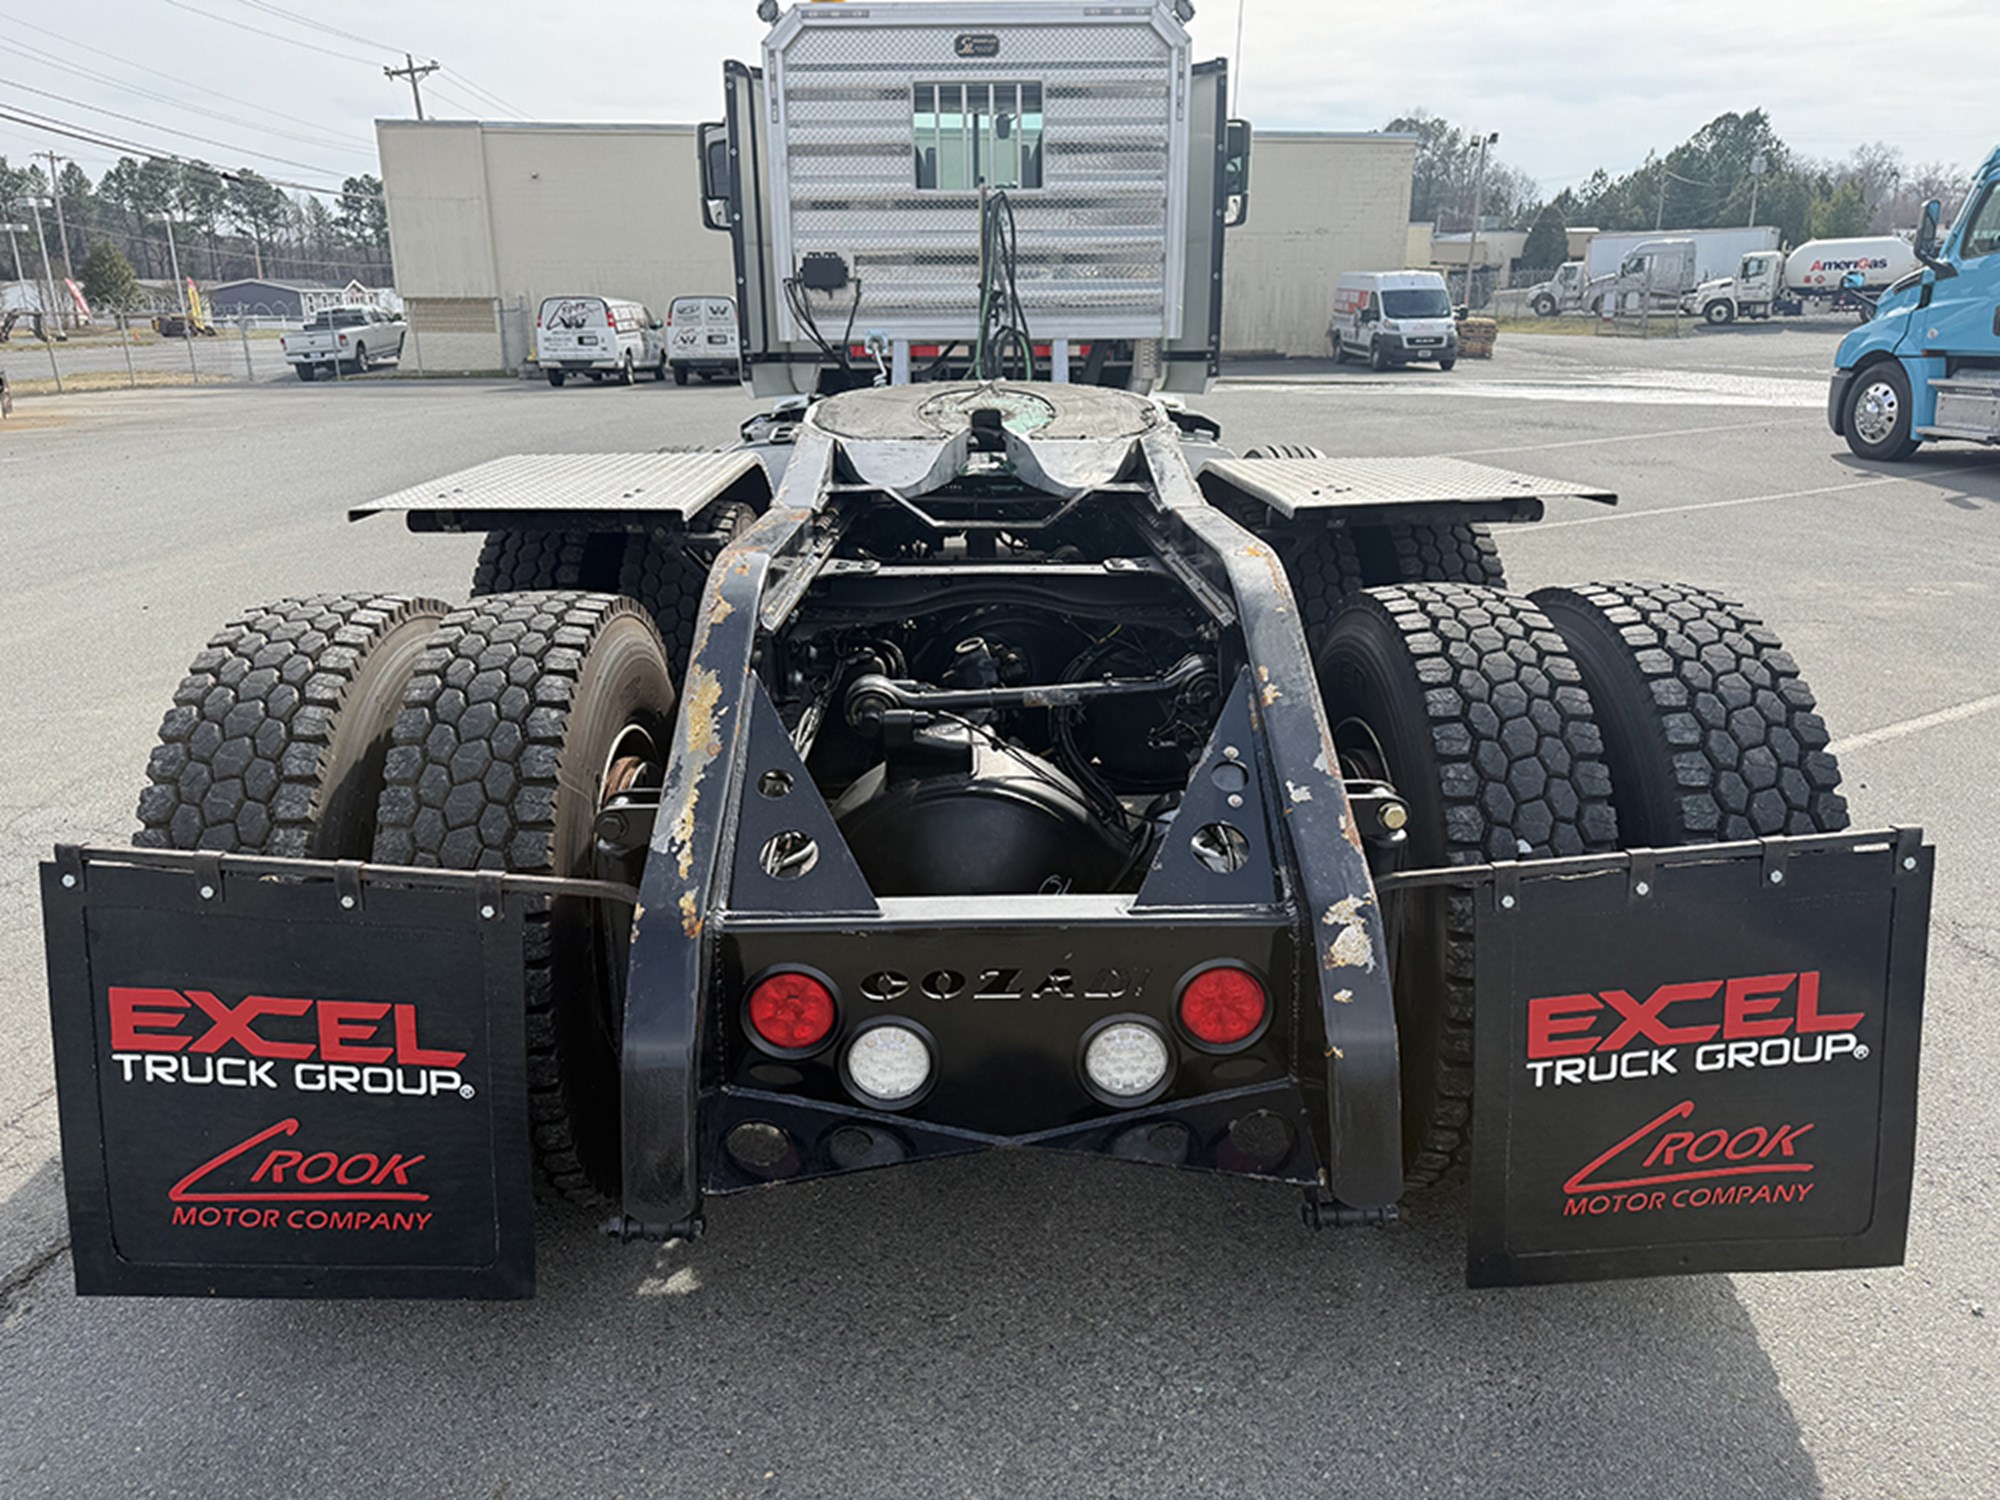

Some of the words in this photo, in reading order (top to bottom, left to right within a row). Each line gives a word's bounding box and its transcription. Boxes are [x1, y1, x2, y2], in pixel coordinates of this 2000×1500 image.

[1810, 258, 1887, 271] AmeriGas
[108, 986, 467, 1069] EXCEL
[1527, 971, 1865, 1060] EXCEL
[111, 1053, 277, 1088] TRUCK
[1525, 1047, 1678, 1087] TRUCK
[1563, 1191, 1667, 1217] MOTOR
[1671, 1184, 1815, 1209] COMPANY
[172, 1206, 279, 1229] MOTOR
[286, 1210, 433, 1231] COMPANY
